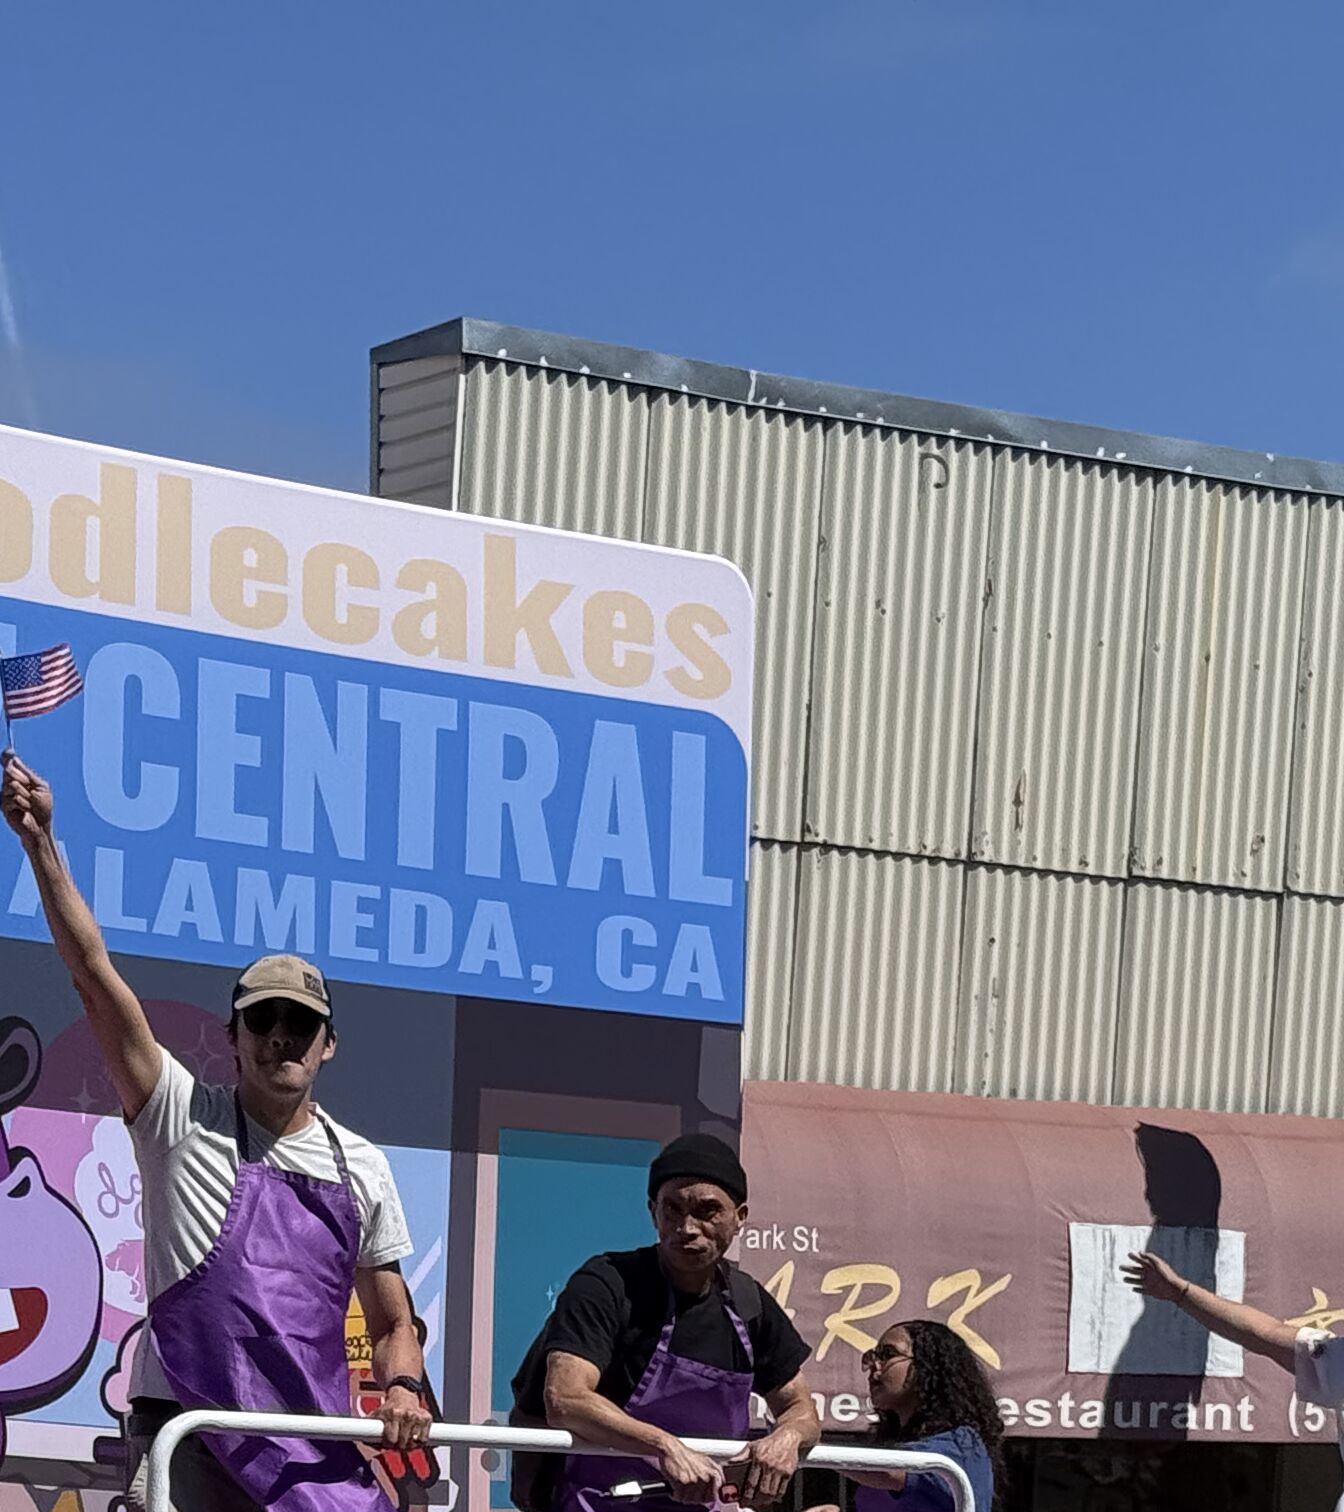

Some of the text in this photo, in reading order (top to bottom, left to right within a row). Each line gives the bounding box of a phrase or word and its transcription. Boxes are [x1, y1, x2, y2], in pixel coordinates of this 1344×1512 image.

[81, 641, 734, 907] CENTRAL
[595, 914, 725, 1001] CA
[739, 1223, 820, 1253] ark St
[764, 1260, 1013, 1370] RK
[997, 1390, 1325, 1438] estaurant (5
